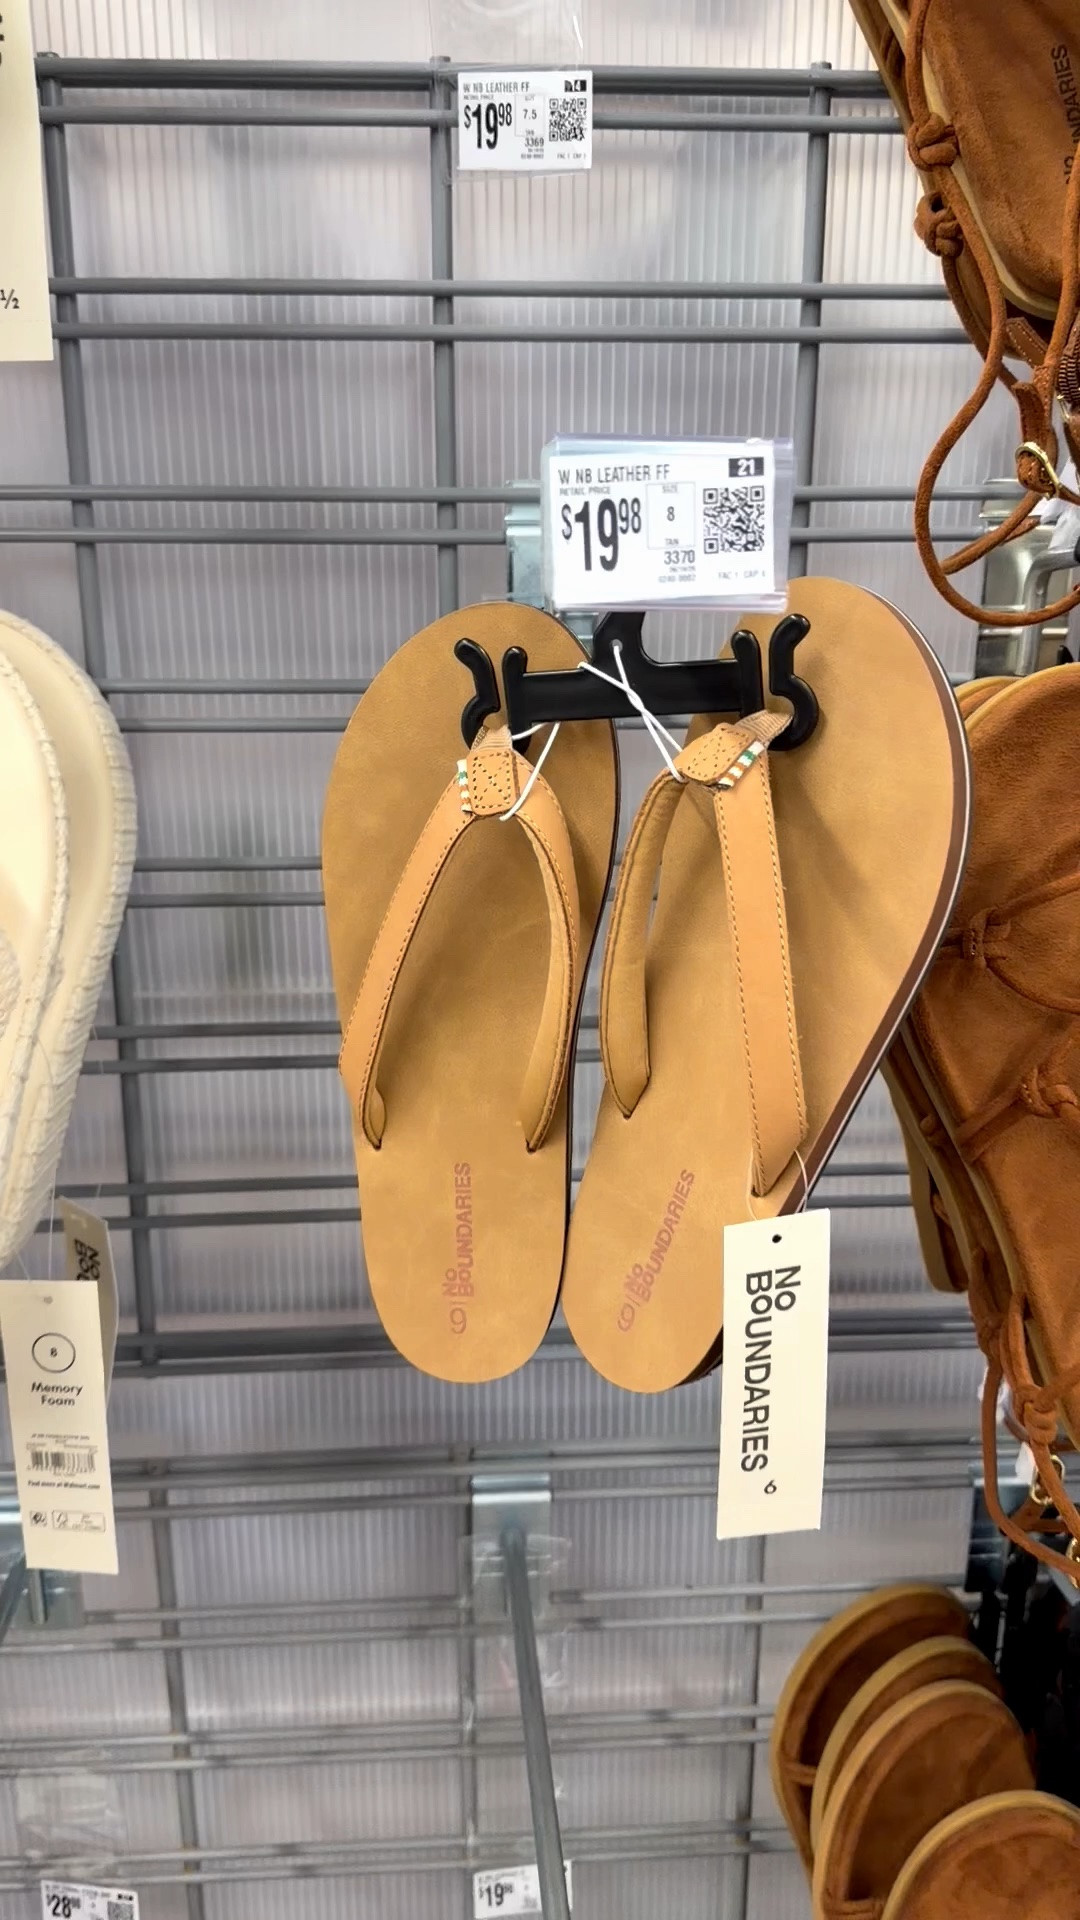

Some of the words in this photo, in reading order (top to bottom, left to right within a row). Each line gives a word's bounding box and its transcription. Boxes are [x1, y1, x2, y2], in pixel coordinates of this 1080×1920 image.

[463, 83, 472, 93] W
[473, 82, 484, 93] NB
[485, 82, 519, 93] LEATHER
[521, 81, 530, 92] FF
[522, 109, 537, 120] 7.5
[525, 138, 545, 148] 3369
[558, 468, 571, 485] W
[576, 467, 592, 484] NB
[597, 465, 651, 483] LEATHER
[656, 464, 670, 480] FF
[666, 506, 675, 522] 8
[664, 549, 696, 565] 3370
[453, 1161, 475, 1298] BOUNDARIES
[633, 1168, 695, 1303] BOUNDARIES
[441, 1267, 458, 1297] NO
[622, 1262, 644, 1294] NO
[774, 1265, 802, 1312] NO
[740, 1269, 773, 1473] BOUNDARIES
[31, 1381, 83, 1397] Memory
[41, 1394, 76, 1406] Foam
